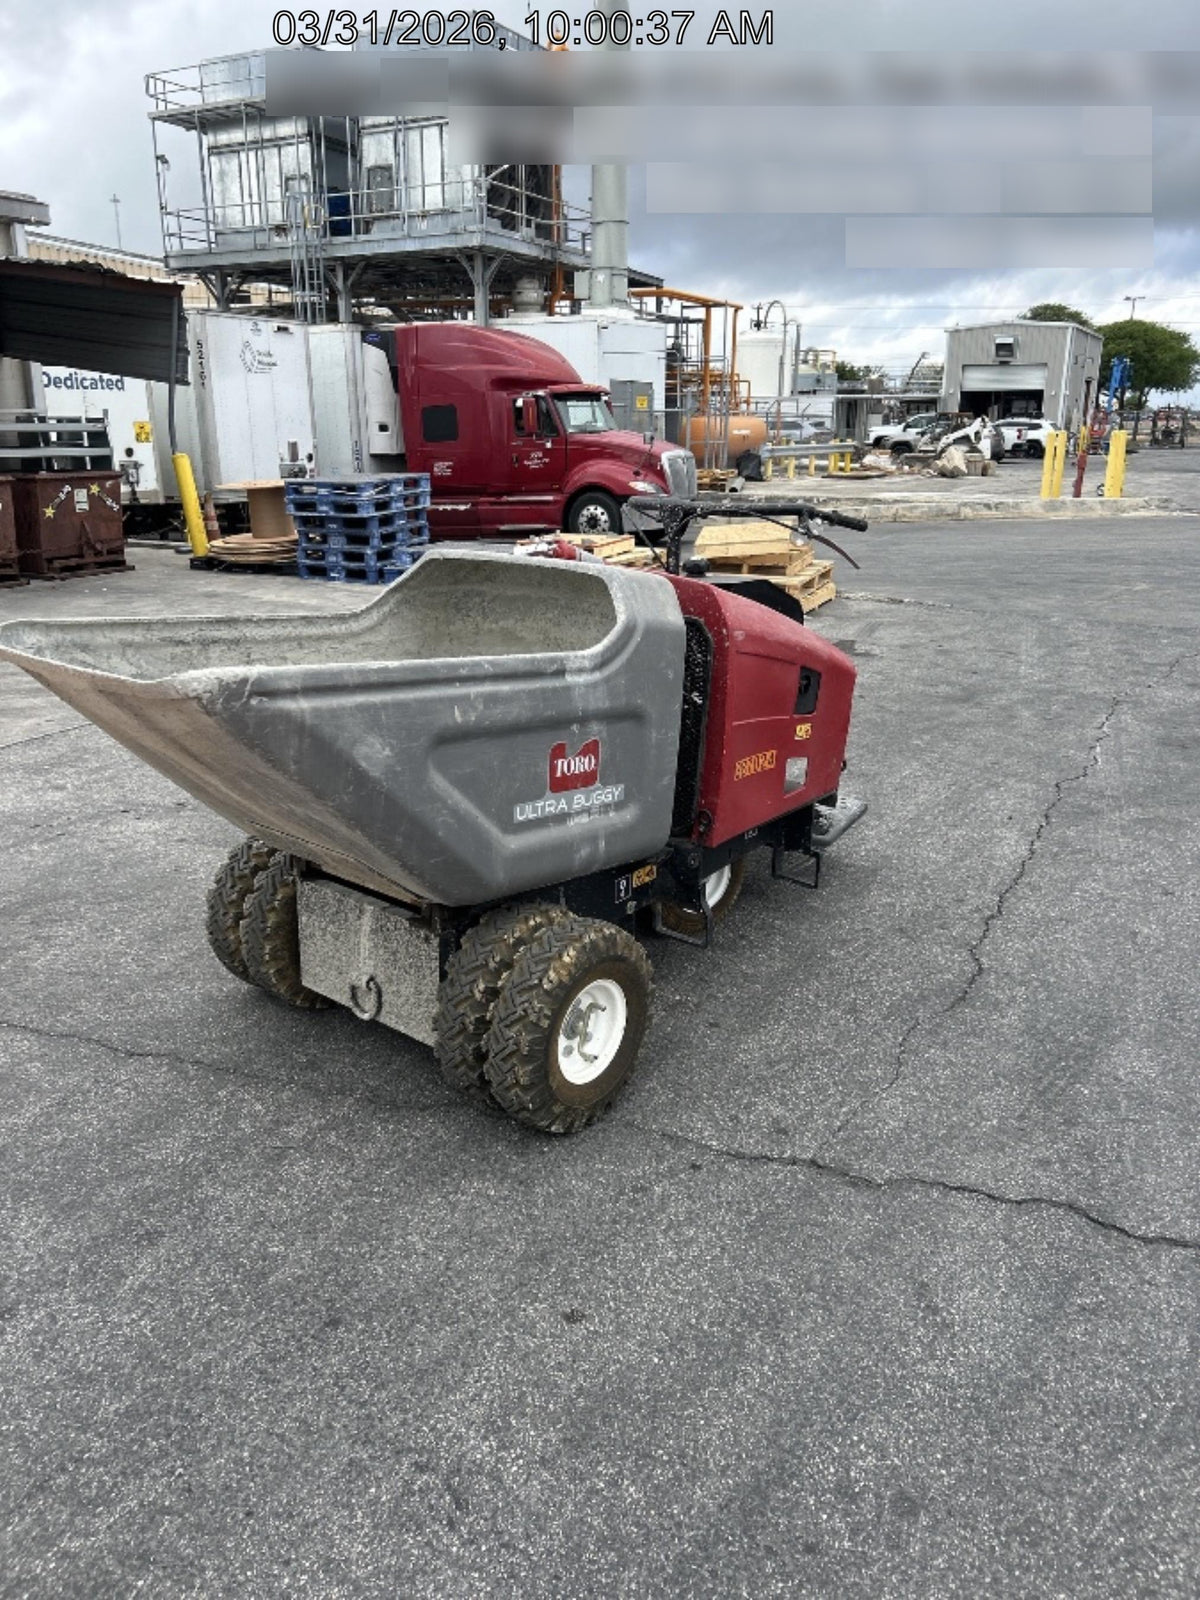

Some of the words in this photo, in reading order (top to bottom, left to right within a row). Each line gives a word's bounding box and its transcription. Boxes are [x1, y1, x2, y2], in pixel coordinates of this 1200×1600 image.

[41, 370, 126, 392] Dedicated
[554, 752, 597, 778] TORO
[516, 799, 568, 821] ULTRA
[573, 786, 622, 809] BUGGY
